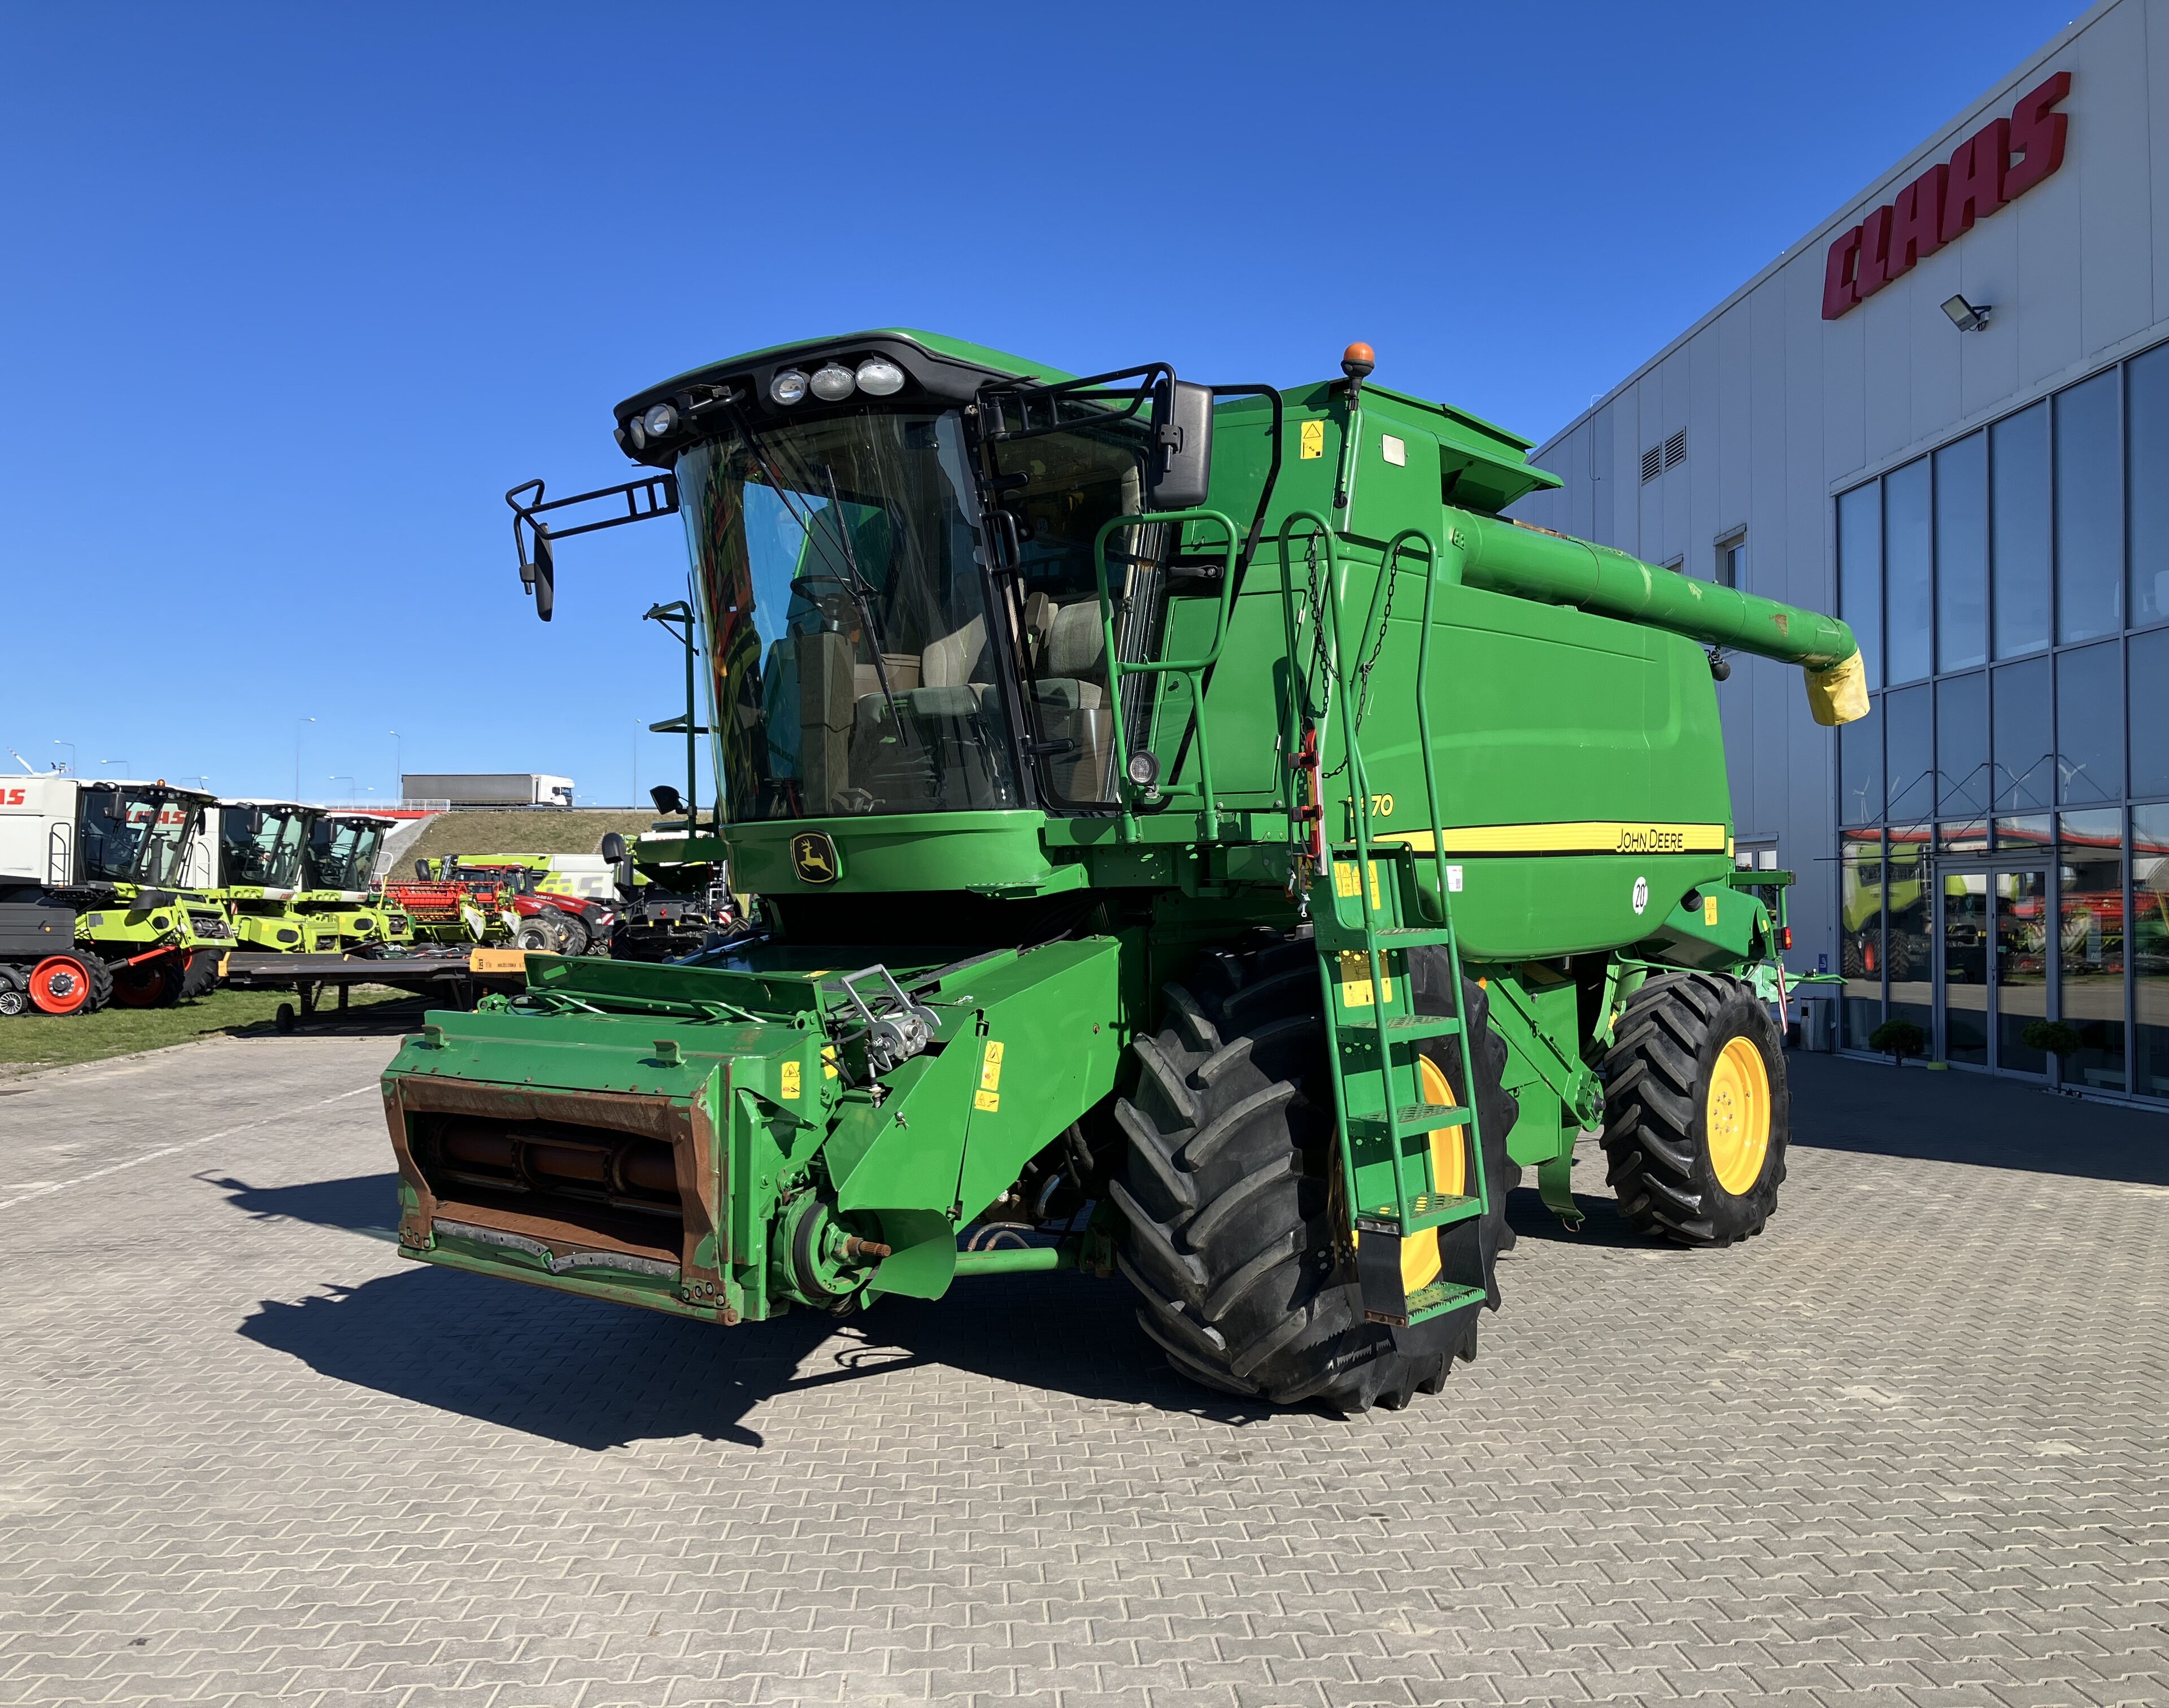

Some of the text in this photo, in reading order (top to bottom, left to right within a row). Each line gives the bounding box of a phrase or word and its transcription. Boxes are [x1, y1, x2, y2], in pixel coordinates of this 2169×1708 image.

[1822, 71, 2071, 320] CLAAS
[1348, 794, 1393, 818] 70
[1617, 829, 1683, 849] JOHN DEERE
[1635, 883, 1645, 908] 20
